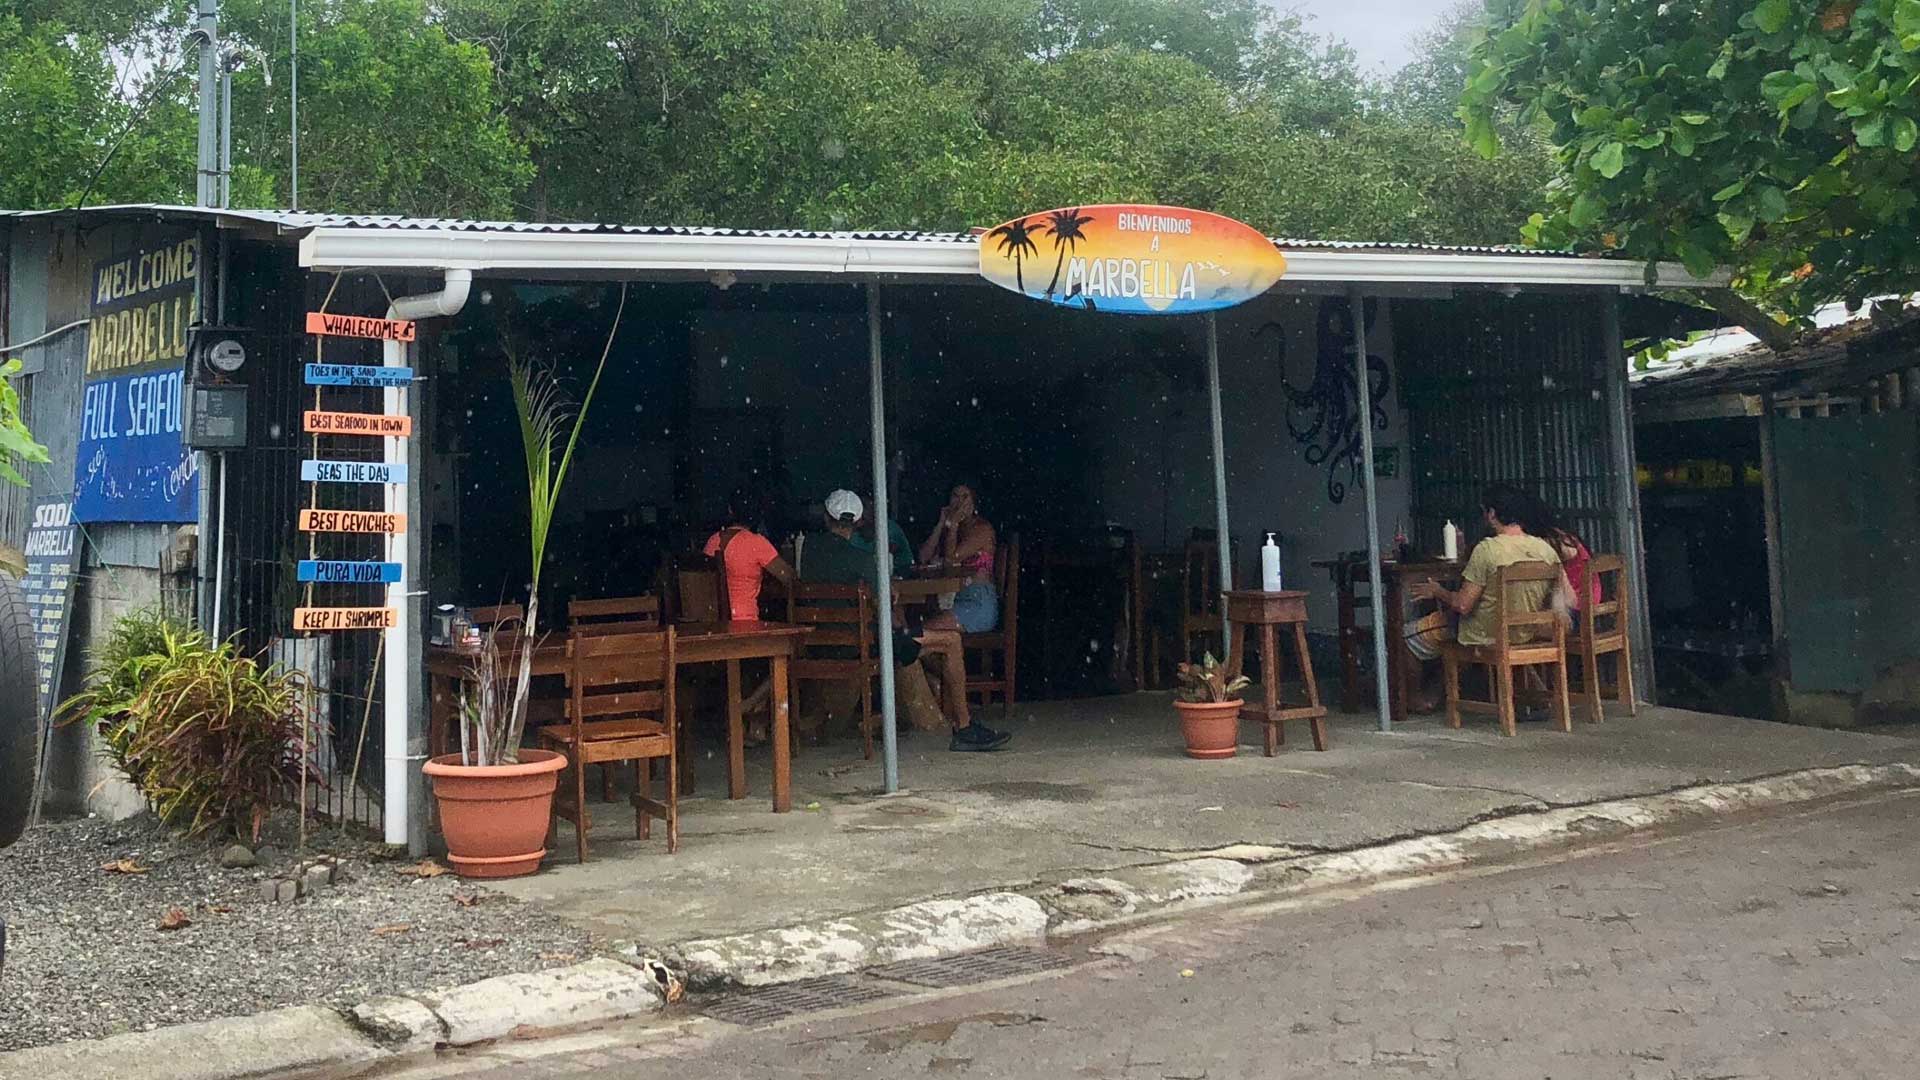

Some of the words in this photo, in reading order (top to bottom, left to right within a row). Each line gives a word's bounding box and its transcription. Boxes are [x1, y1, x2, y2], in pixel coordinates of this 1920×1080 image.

[1118, 213, 1192, 234] BIENVENIDOS
[1151, 235, 1159, 252] A
[96, 238, 197, 305] WELCOME
[1064, 256, 1196, 300] MARBELLA
[322, 315, 400, 339] WHALECOME
[310, 365, 330, 376] TOES
[332, 366, 340, 376] IN
[341, 366, 354, 377] THE
[357, 367, 377, 377] SAND
[82, 382, 118, 441] FULL
[310, 413, 332, 430] BEST
[335, 414, 368, 430] SEAFOOD
[370, 418, 379, 431] IN
[381, 418, 403, 431] TOWN
[317, 463, 342, 480] SEAS
[346, 464, 364, 480] THE
[368, 465, 389, 482] DAY
[309, 511, 339, 531] BEST
[342, 513, 395, 532] CEVICHES
[24, 529, 74, 556] MARBELLA
[316, 562, 351, 581] PURA
[353, 563, 382, 581] VIDA
[302, 611, 330, 628] KEEP
[332, 611, 342, 628] IT
[345, 610, 390, 628] SHRIMPLE
